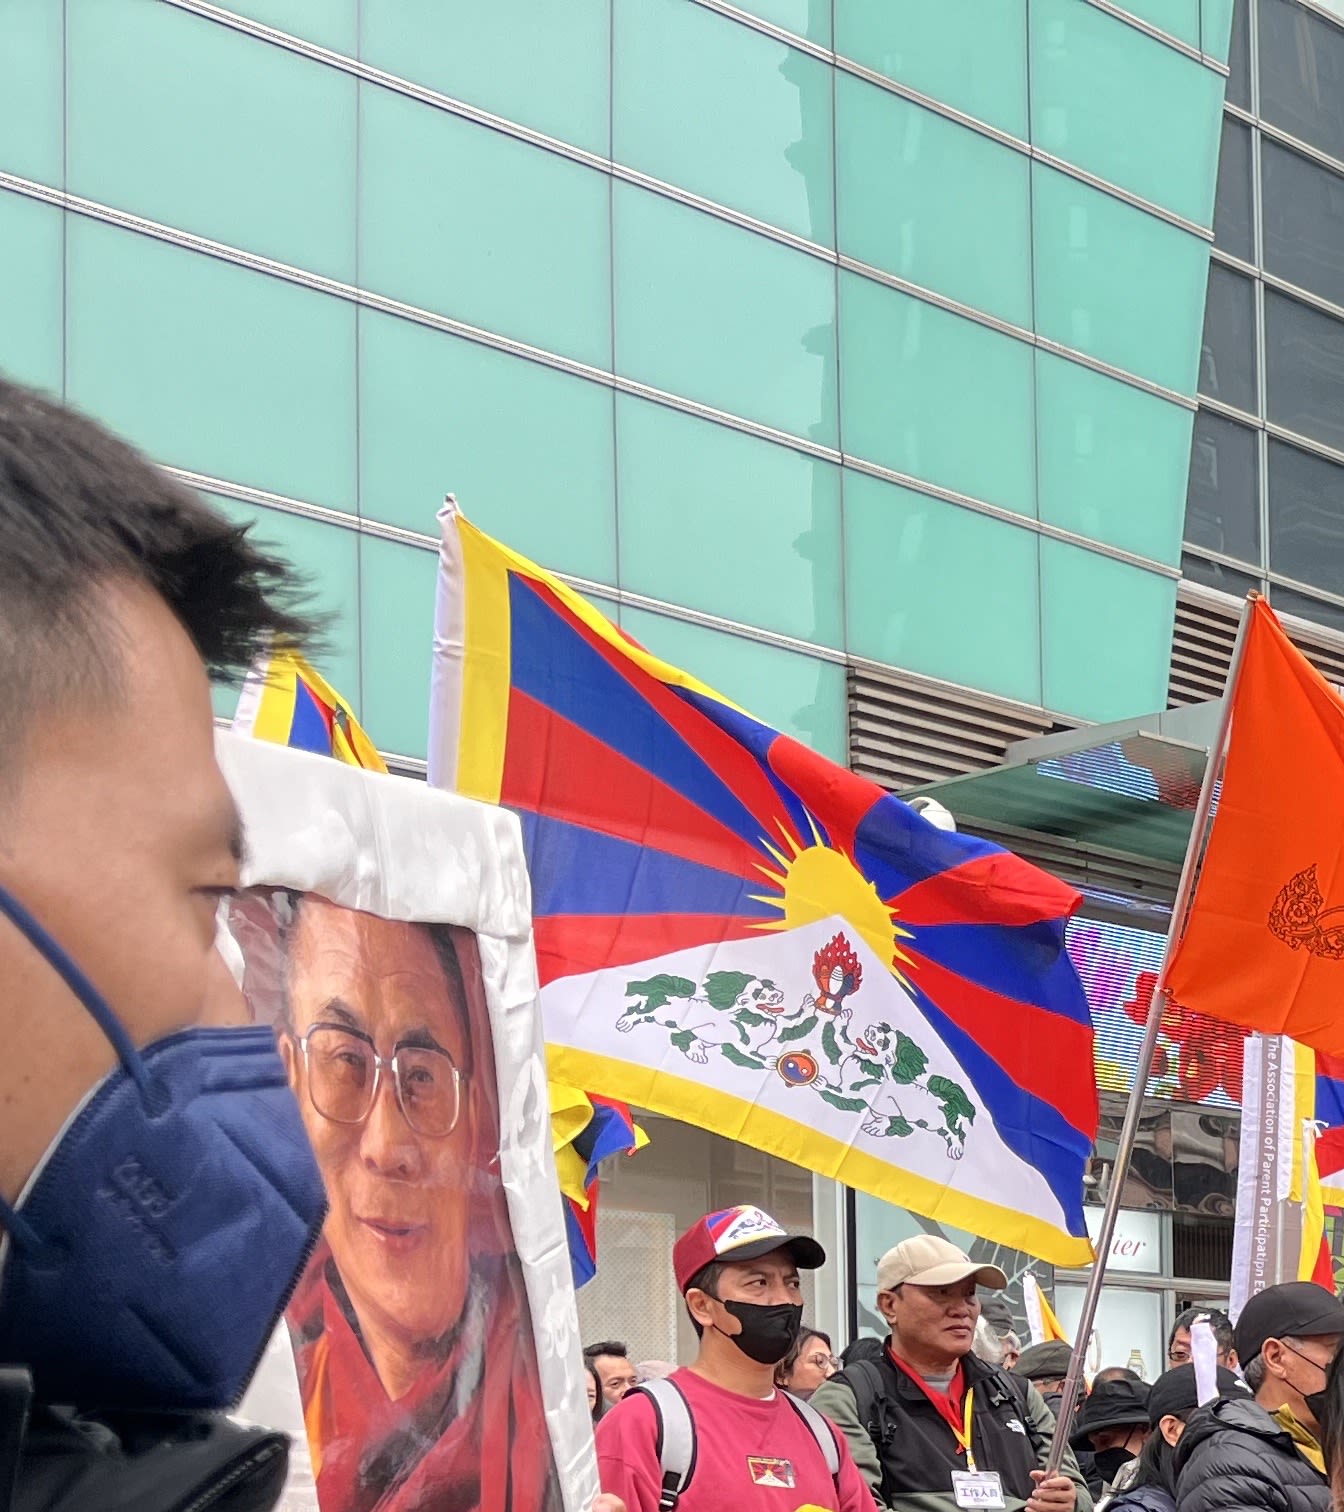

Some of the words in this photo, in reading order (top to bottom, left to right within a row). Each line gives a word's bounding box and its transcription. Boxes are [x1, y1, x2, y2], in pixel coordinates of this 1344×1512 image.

[1266, 1036, 1280, 1060] The
[1264, 1062, 1279, 1134] Association
[1263, 1136, 1276, 1150] of
[1259, 1153, 1274, 1195] Parent
[1253, 1197, 1272, 1277] Participation
